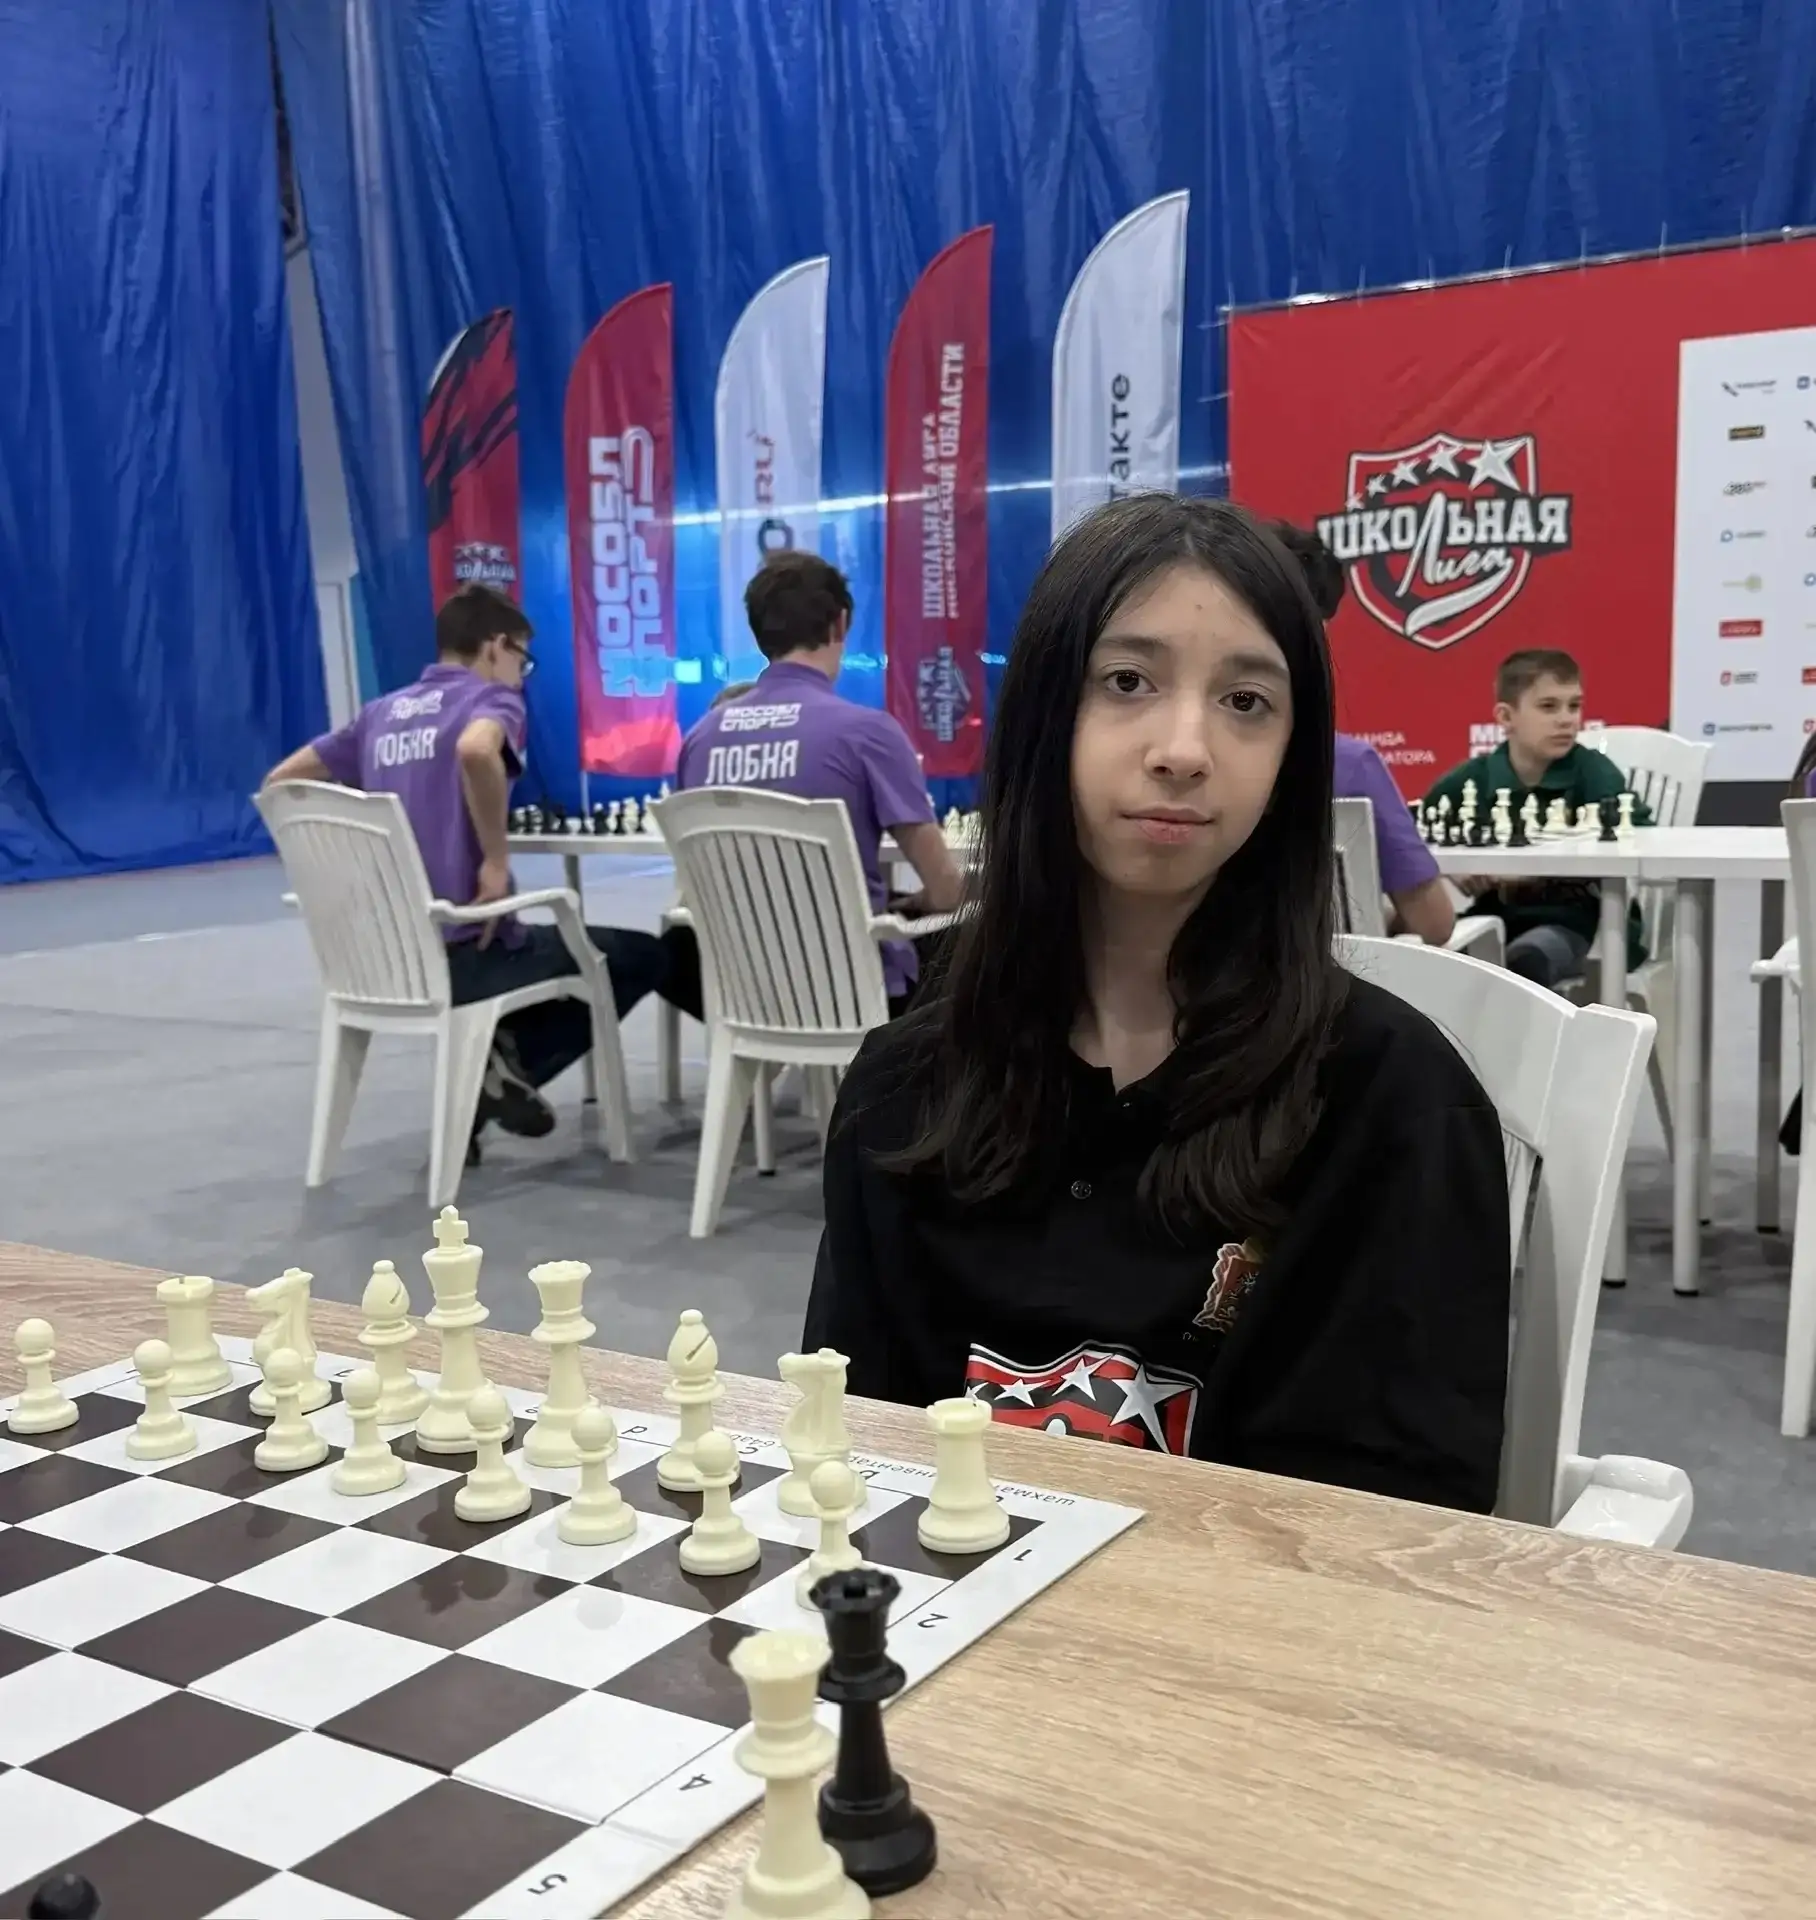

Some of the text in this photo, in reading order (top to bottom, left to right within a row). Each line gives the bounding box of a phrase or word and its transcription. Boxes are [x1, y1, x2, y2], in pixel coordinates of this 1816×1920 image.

[938, 343, 964, 457] ОБЛАСТИ
[1317, 493, 1571, 560] ШКОЛЬНАЯ
[588, 436, 634, 697] МОСОБЛ
[623, 491, 666, 697] СПОРТ
[704, 740, 799, 786] ЛОБНЯ
[994, 1484, 1076, 1505] шахма
[917, 1613, 949, 1628] 2
[679, 1773, 713, 1791] 4
[527, 1873, 568, 1895] 5
